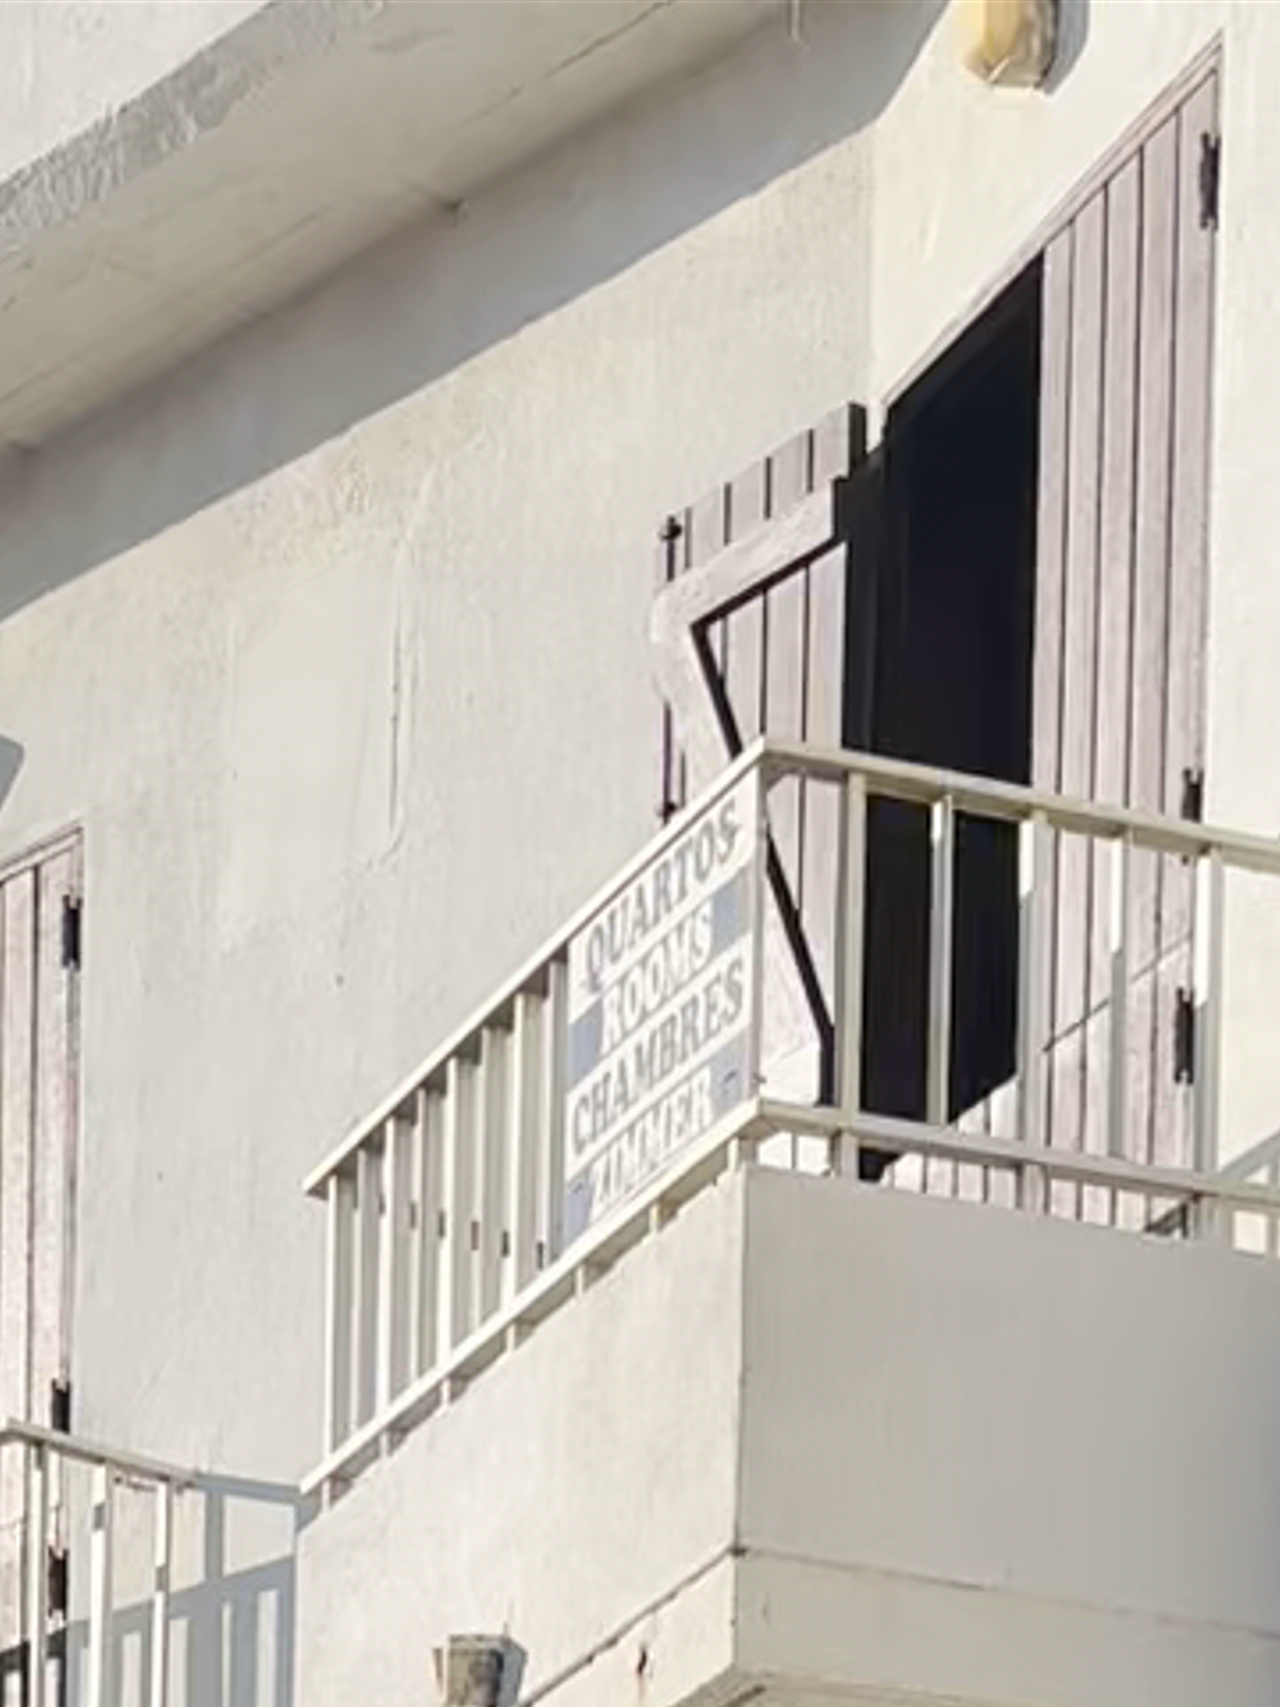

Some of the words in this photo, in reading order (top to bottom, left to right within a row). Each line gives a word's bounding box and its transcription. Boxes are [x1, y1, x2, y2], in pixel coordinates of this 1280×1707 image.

[585, 796, 742, 992] QUARTOS
[603, 905, 713, 1056] ROOMS
[571, 957, 745, 1155] CHAMBRES
[593, 1066, 713, 1206] ZIMMER
